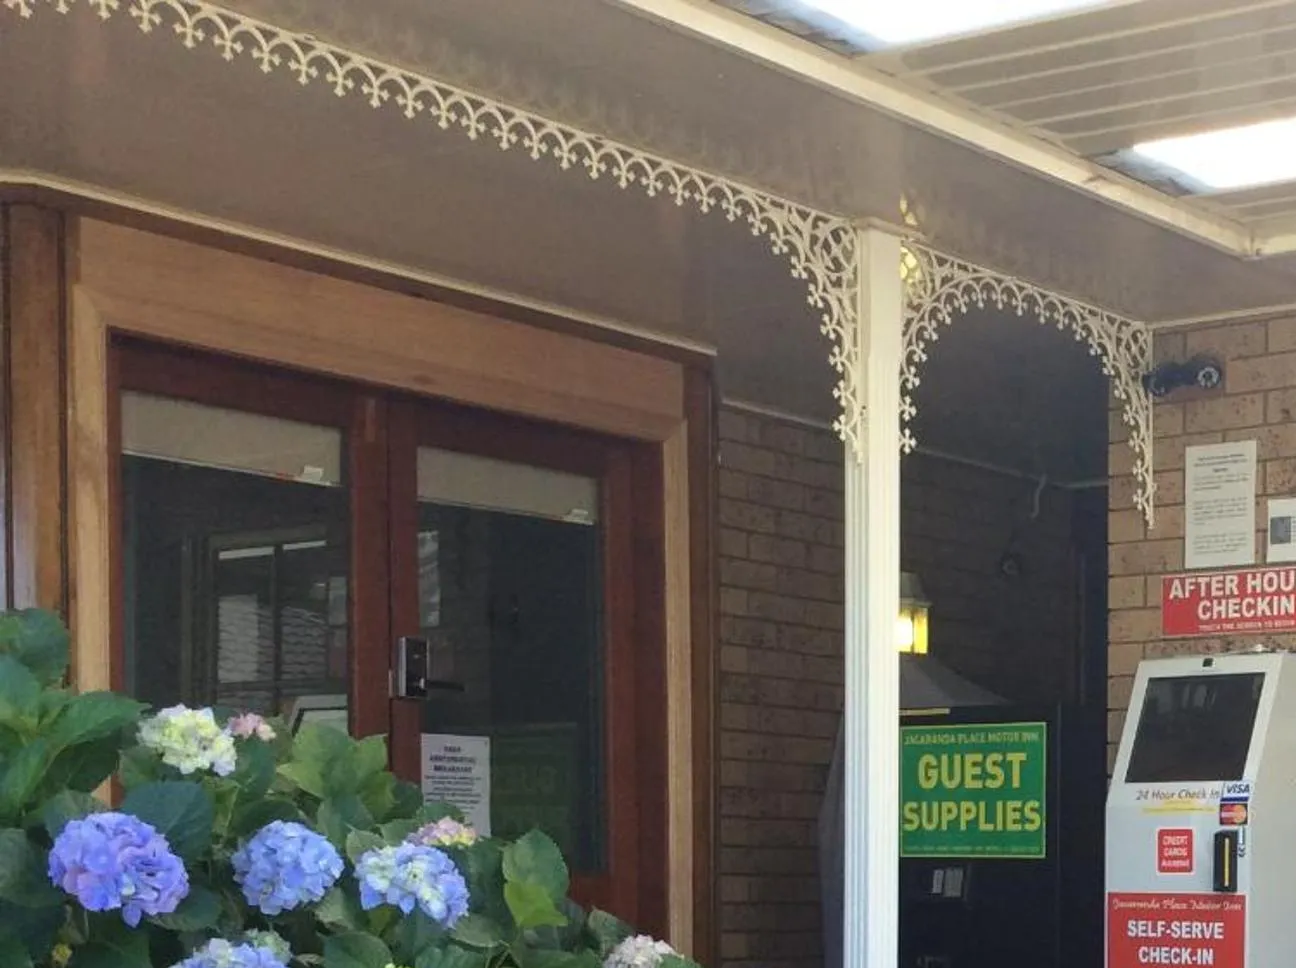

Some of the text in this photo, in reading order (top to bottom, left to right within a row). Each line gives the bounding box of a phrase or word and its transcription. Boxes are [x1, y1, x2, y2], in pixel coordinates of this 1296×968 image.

[1169, 575, 1239, 600] AFTER
[1197, 595, 1296, 621] CHECKIN
[917, 752, 1028, 790] GUEST
[1152, 789, 1175, 799] Hour
[1178, 788, 1206, 799] Check
[1226, 783, 1250, 794] VISA
[902, 799, 1042, 832] SUPPLIES
[1127, 919, 1225, 939] SELF-SERVE
[1138, 946, 1214, 965] CHECK-IN
